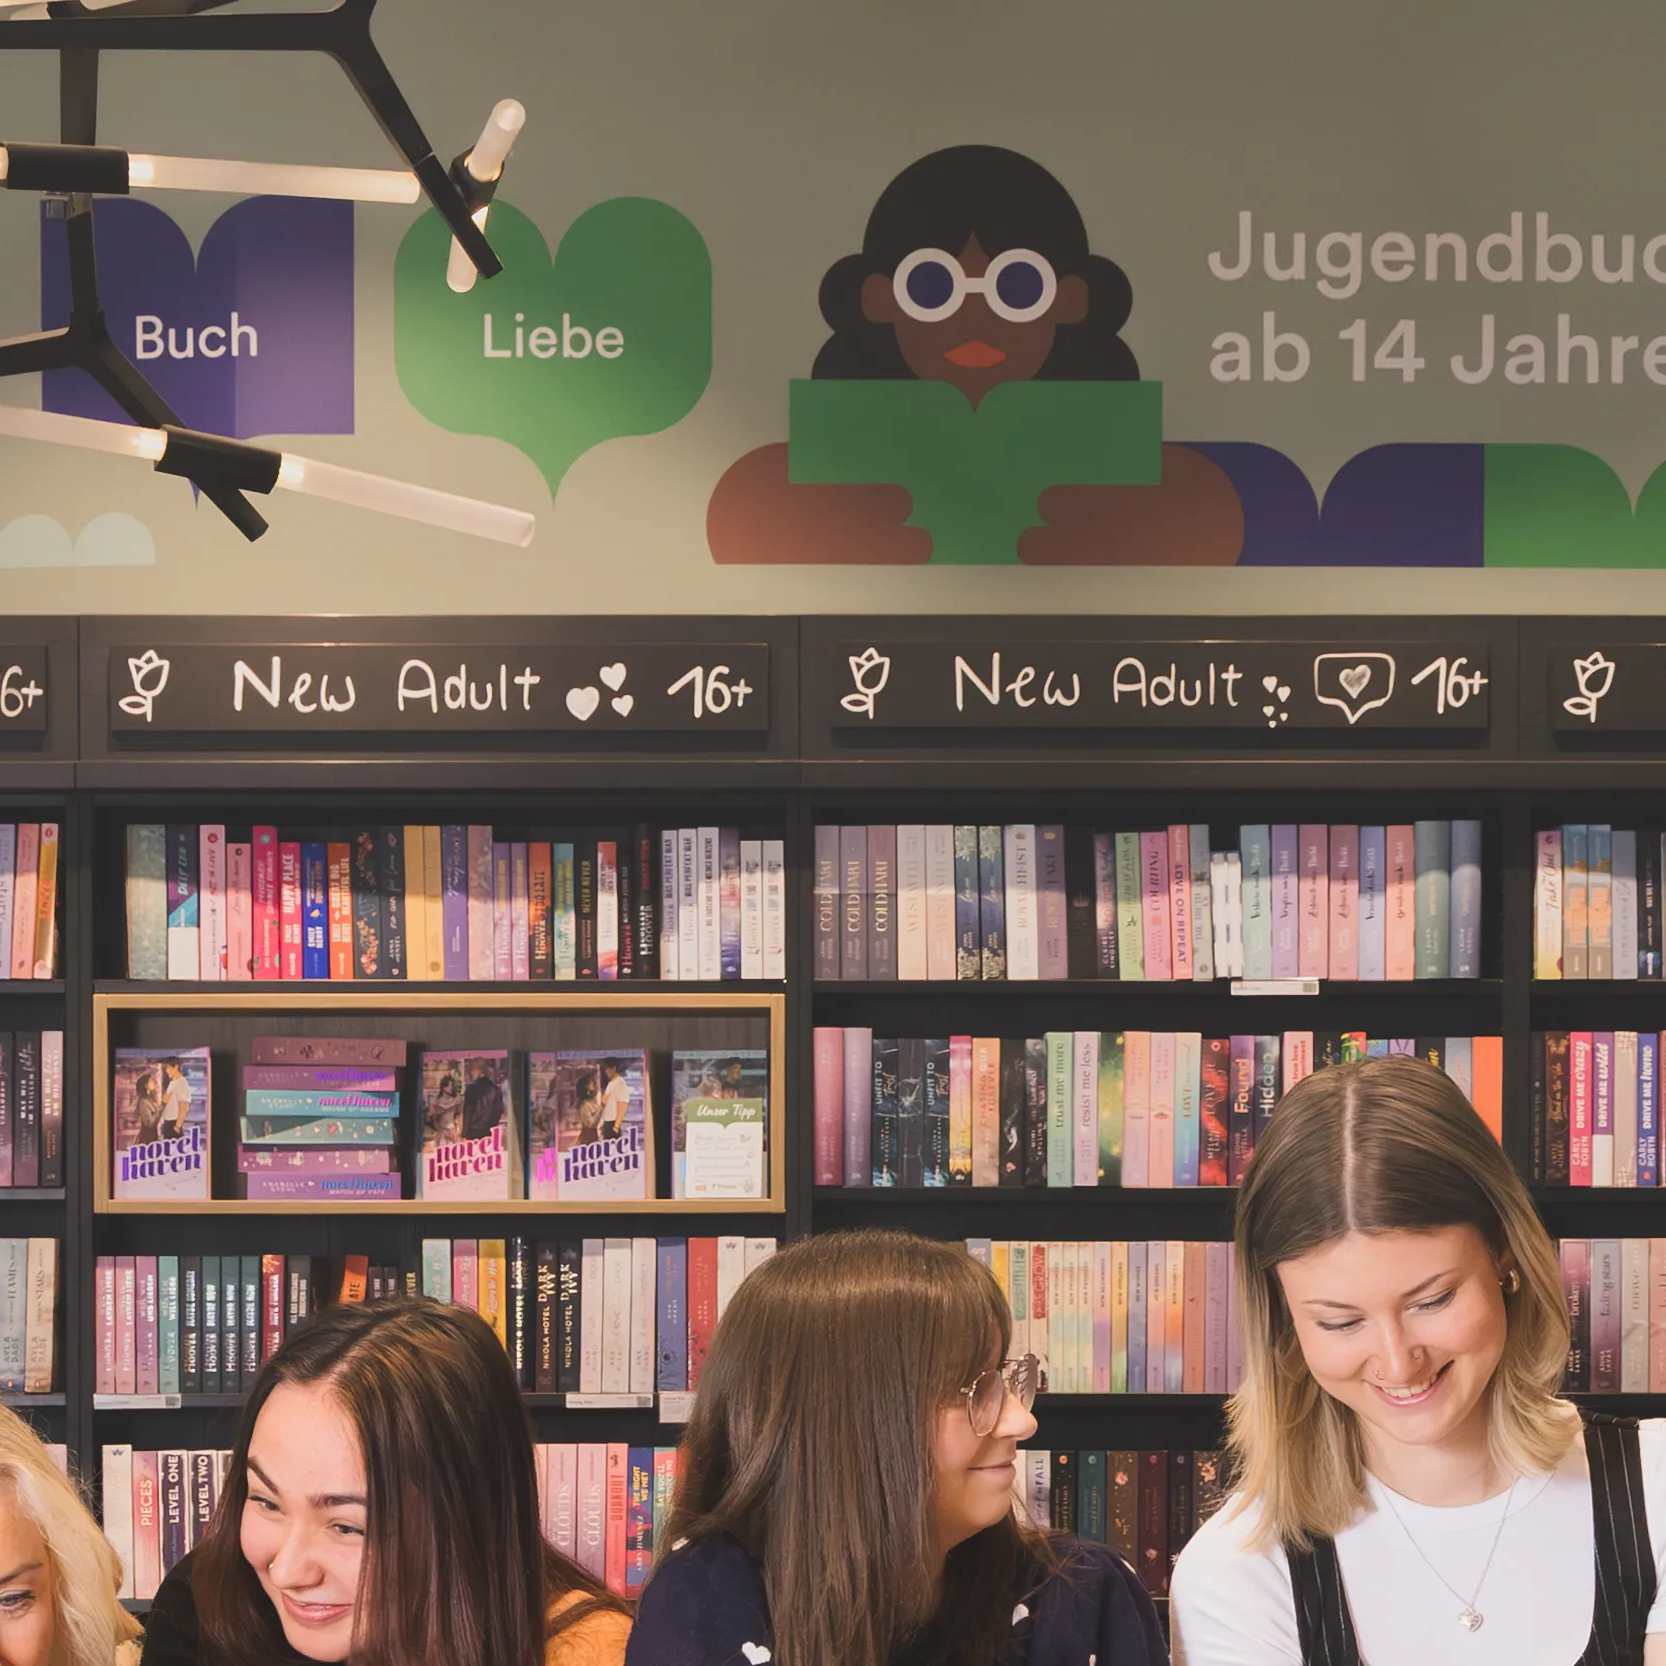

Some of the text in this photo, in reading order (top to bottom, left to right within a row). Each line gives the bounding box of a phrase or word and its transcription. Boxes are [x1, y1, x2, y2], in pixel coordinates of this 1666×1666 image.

[136, 312, 258, 359] Buch
[483, 313, 623, 359] Liebe
[1210, 312, 1310, 382] ab
[1339, 319, 1425, 382] 14
[234, 656, 751, 718] New Adult 16+
[955, 652, 1488, 714] New Adult 16+
[281, 854, 294, 913] HAPPY PLACE
[1054, 1042, 1064, 1128] trust me more
[1081, 1071, 1091, 1091] me
[1234, 1058, 1251, 1113] Found
[1260, 1052, 1275, 1117] Hidden
[1573, 1041, 1590, 1129] DRIVE ME crazy
[1595, 1043, 1610, 1128] DRIVE ME wild
[732, 1103, 756, 1119] Tipp
[1080, 1094, 1092, 1128] resist
[121, 1152, 201, 1182] haven
[130, 1125, 200, 1162] novel
[429, 1151, 503, 1183] haven
[436, 1125, 503, 1163] novel
[563, 1151, 640, 1183] haven
[571, 1125, 638, 1163] novel
[538, 1264, 547, 1303] DARK
[542, 1306, 550, 1369] NIKOLA HOTEL
[140, 1479, 153, 1526] PIECES
[168, 1456, 180, 1523] LEVEL ONE
[198, 1456, 209, 1522] LEVEL TWO
